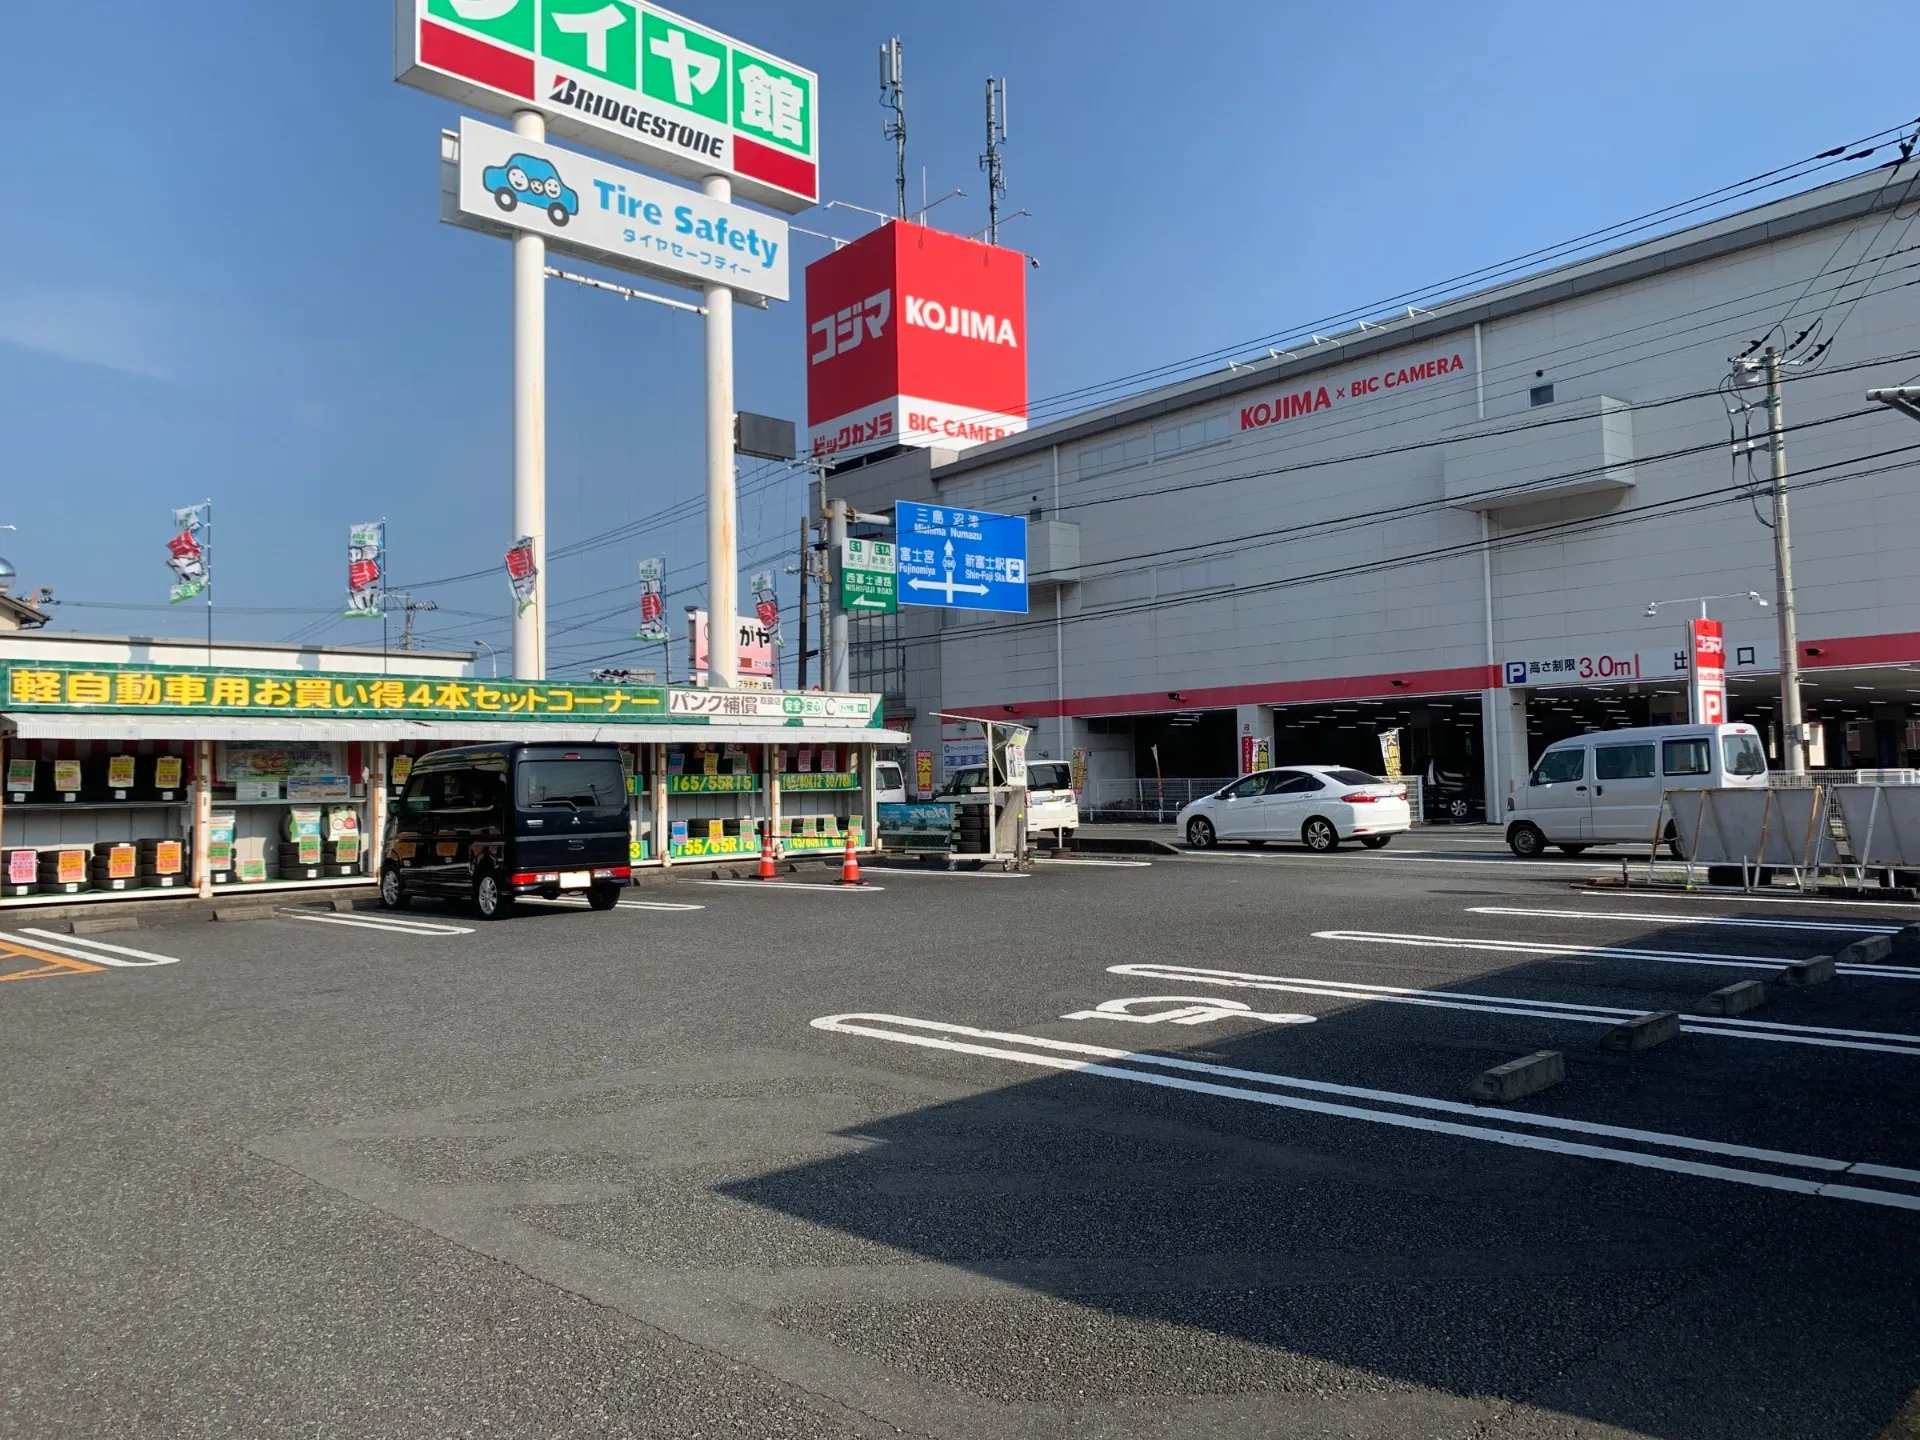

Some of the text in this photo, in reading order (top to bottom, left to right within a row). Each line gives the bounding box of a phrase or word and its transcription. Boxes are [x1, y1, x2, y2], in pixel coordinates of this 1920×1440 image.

[445, 0, 805, 147] イヤ館
[548, 75, 725, 159] BRIDGESTONE
[593, 178, 779, 270] Tire Safety
[623, 228, 752, 274] タイヤセーフティー
[811, 288, 891, 366] コジマ
[905, 295, 1018, 348] KOJIMA
[1240, 386, 1331, 431] KOJIMA
[1351, 376, 1380, 398] BIC
[1384, 353, 1464, 389] CAMERA
[812, 411, 893, 458] ビックカメラ
[908, 412, 1015, 443] BIC CAMER
[916, 508, 980, 528] 三島 沼津
[914, 523, 983, 541] Mishima Numazu
[851, 541, 860, 551] E1
[875, 544, 890, 555] E1A
[899, 546, 935, 564] 富士宮
[899, 563, 936, 577] Fujinomiya
[964, 554, 1006, 571] 新富士駅
[846, 572, 892, 587] 西富士道路
[965, 570, 994, 583] Shin-Fuji
[845, 583, 893, 595] NISHIFUJI ROAD
[1529, 655, 1632, 679] 高さ制限 3.0m
[11, 669, 661, 713] 軽自動車用お買い得4本セットコーナー
[671, 691, 781, 715] パンク補償 取扱店
[673, 775, 752, 792] 165/55R15
